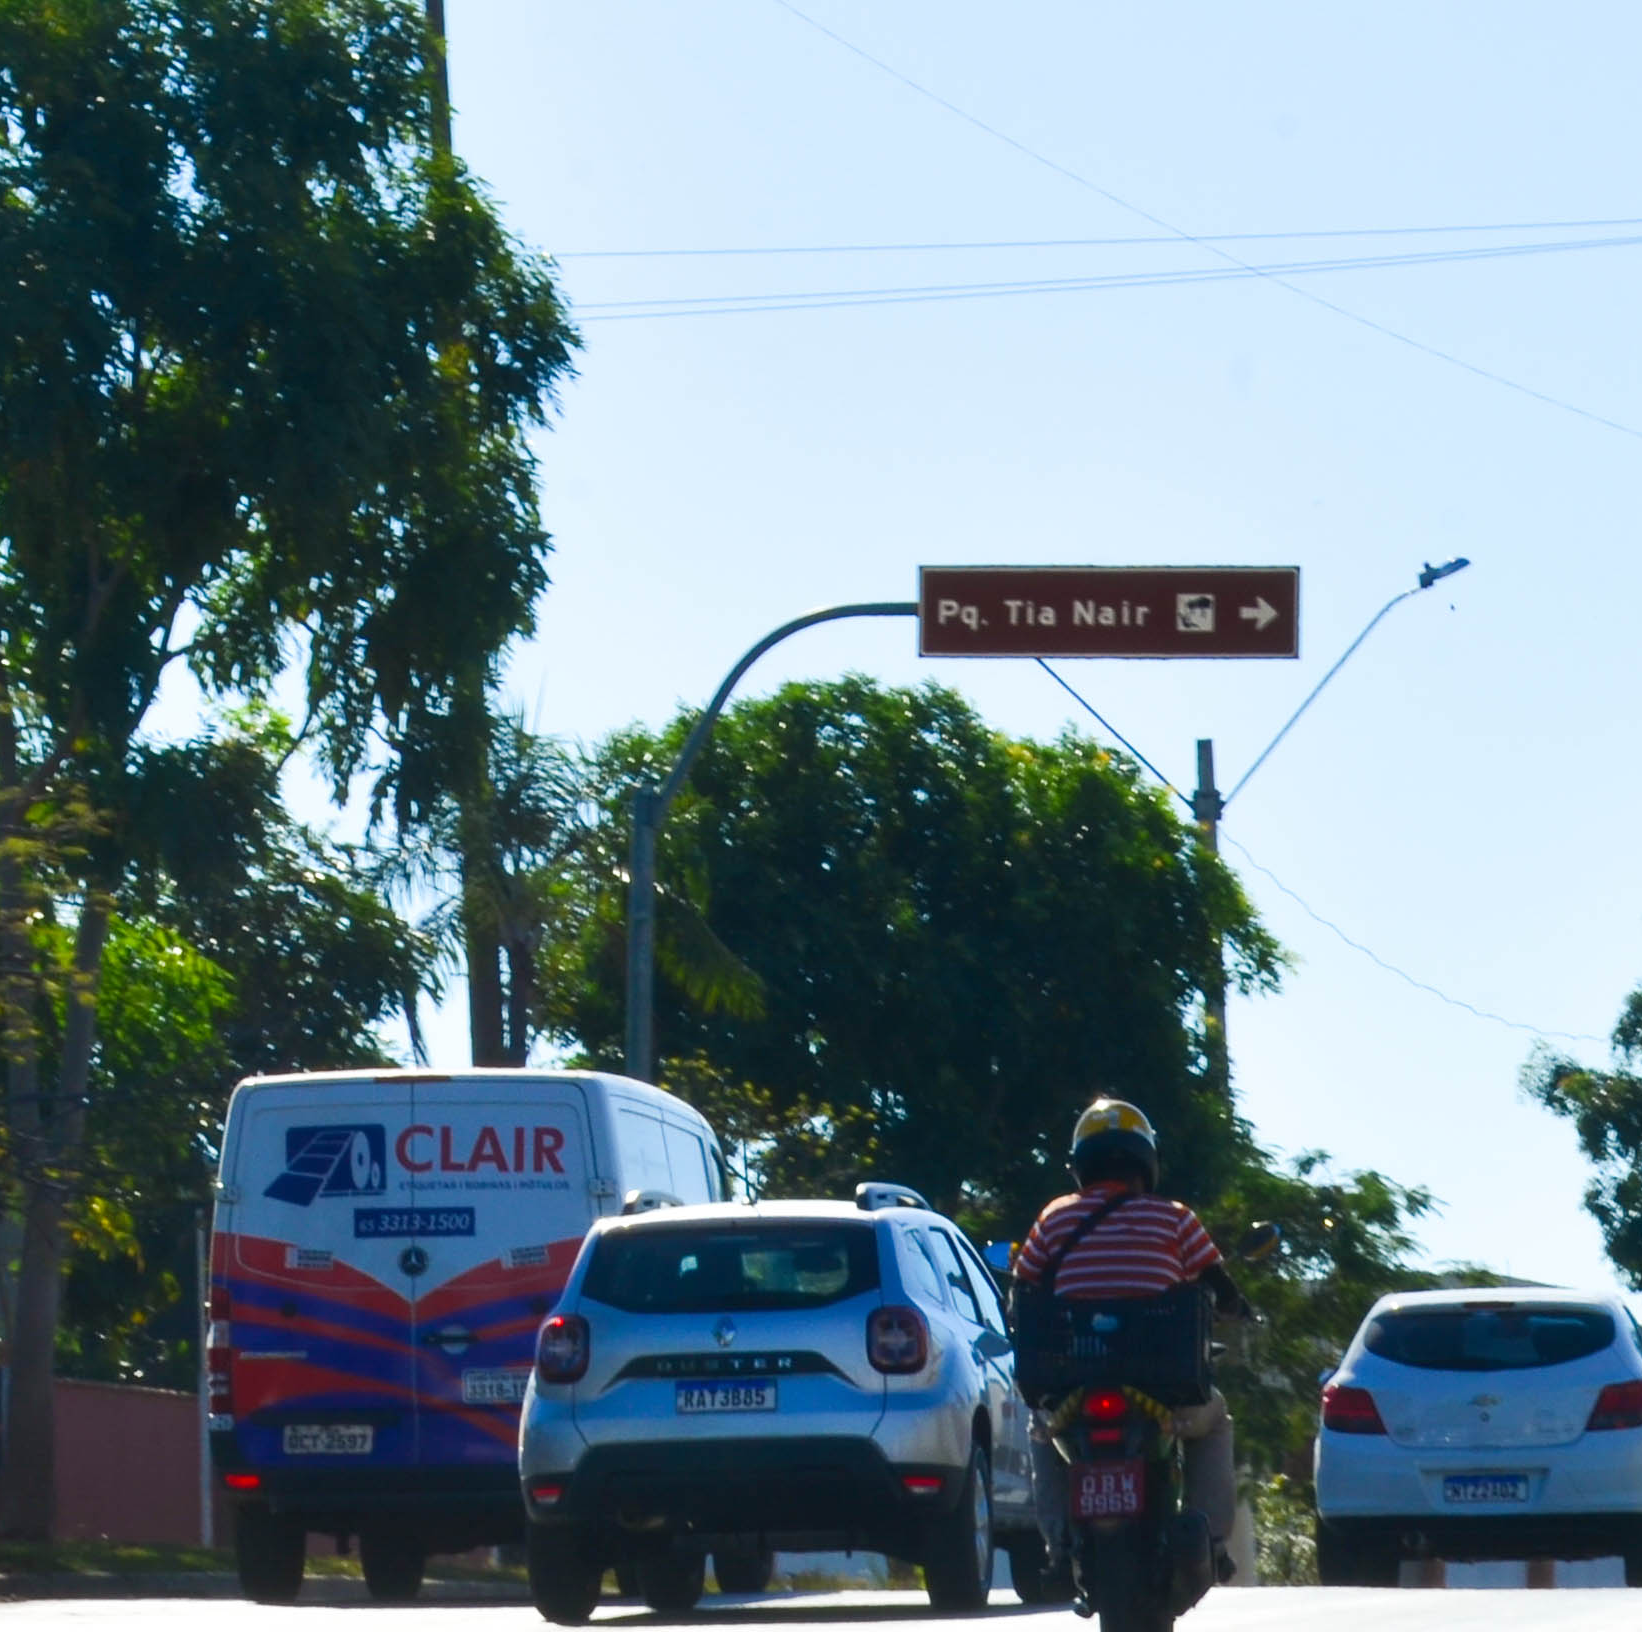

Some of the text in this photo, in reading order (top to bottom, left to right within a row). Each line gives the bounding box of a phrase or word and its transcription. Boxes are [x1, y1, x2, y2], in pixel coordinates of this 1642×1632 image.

[937, 599, 1151, 631] Pq. Tia Nair
[394, 1124, 566, 1174] CLAIR
[378, 1213, 470, 1232] 3313-1500
